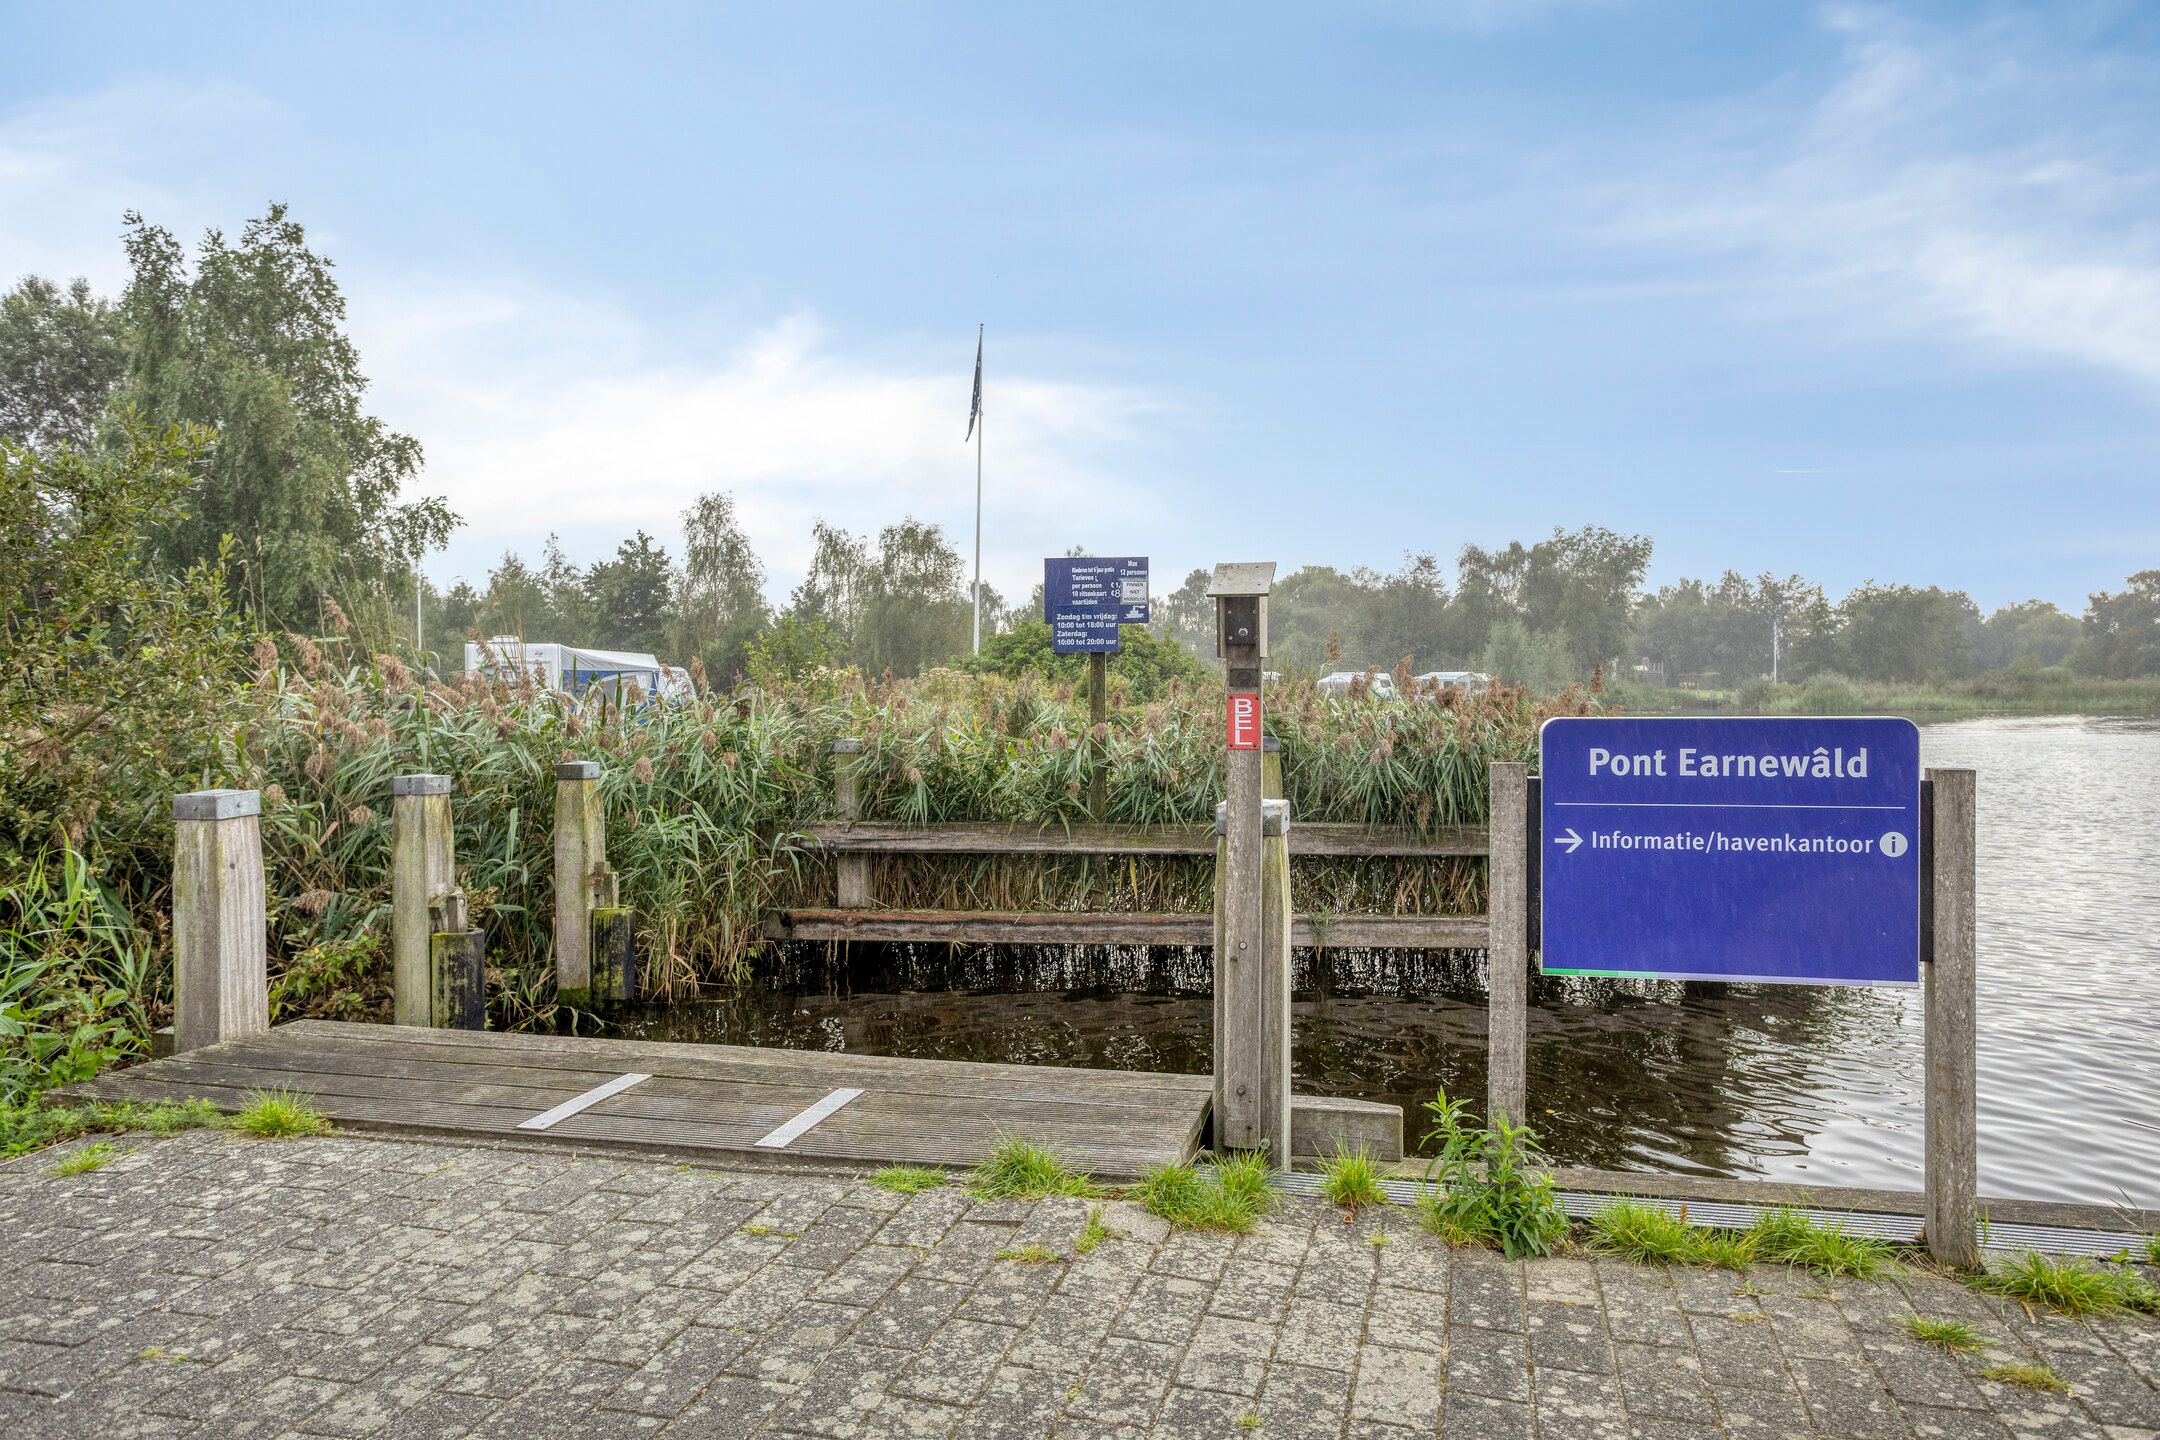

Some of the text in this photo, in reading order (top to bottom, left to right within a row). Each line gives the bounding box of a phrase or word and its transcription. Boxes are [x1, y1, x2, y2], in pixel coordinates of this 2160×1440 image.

[1234, 698, 1253, 745] BEL
[1589, 747, 1868, 778] Pont Earnewâld
[1592, 831, 1873, 854] Informatie/havenkantoor
